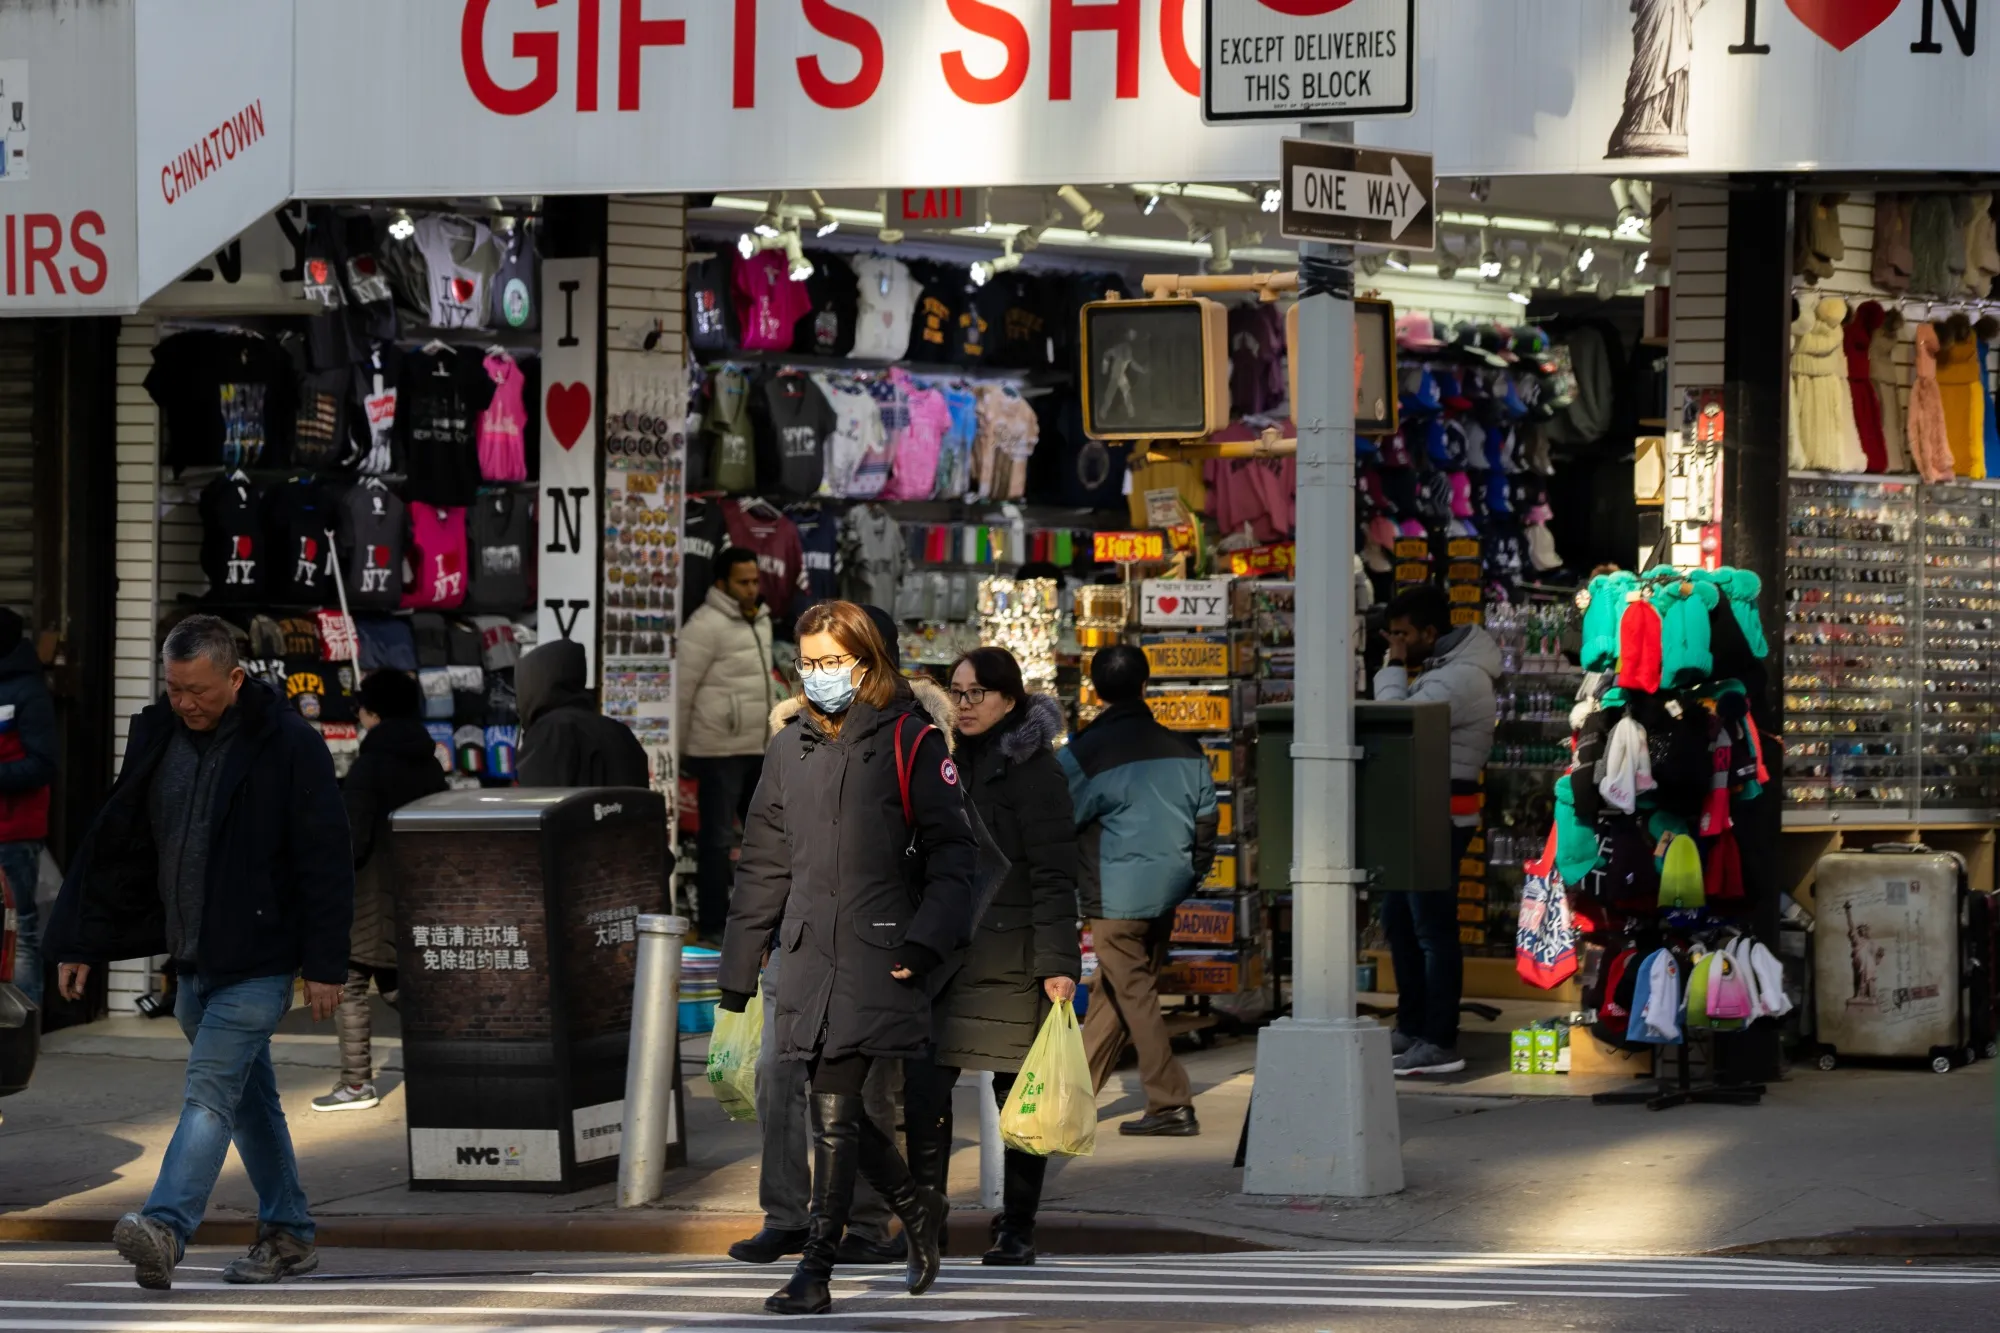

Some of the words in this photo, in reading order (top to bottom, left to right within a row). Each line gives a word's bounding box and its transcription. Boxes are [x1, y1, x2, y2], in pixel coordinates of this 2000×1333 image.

[461, 0, 883, 115] GIFTS
[940, 0, 1200, 104] SH
[1220, 36, 1284, 65] EXCEPT
[1294, 29, 1397, 61] DELIVERIES
[1244, 73, 1290, 101] THIS
[1302, 69, 1371, 99] BLOCK
[161, 98, 265, 205] CHINATOWN
[1304, 172, 1347, 211] ONE
[1367, 179, 1411, 218] WAY
[5, 210, 107, 295] IRS
[558, 281, 579, 347] I
[226, 560, 255, 584] NY
[360, 568, 392, 592] NY
[432, 571, 461, 602] NY
[1145, 596, 1155, 614] I
[1180, 597, 1222, 615] NY
[1148, 647, 1178, 667] TIMES
[1180, 648, 1222, 666] SQUARE
[1152, 701, 1222, 721] BROOKLYN
[423, 948, 529, 970] 免除纽约鼠患
[456, 1146, 500, 1165] NYC
